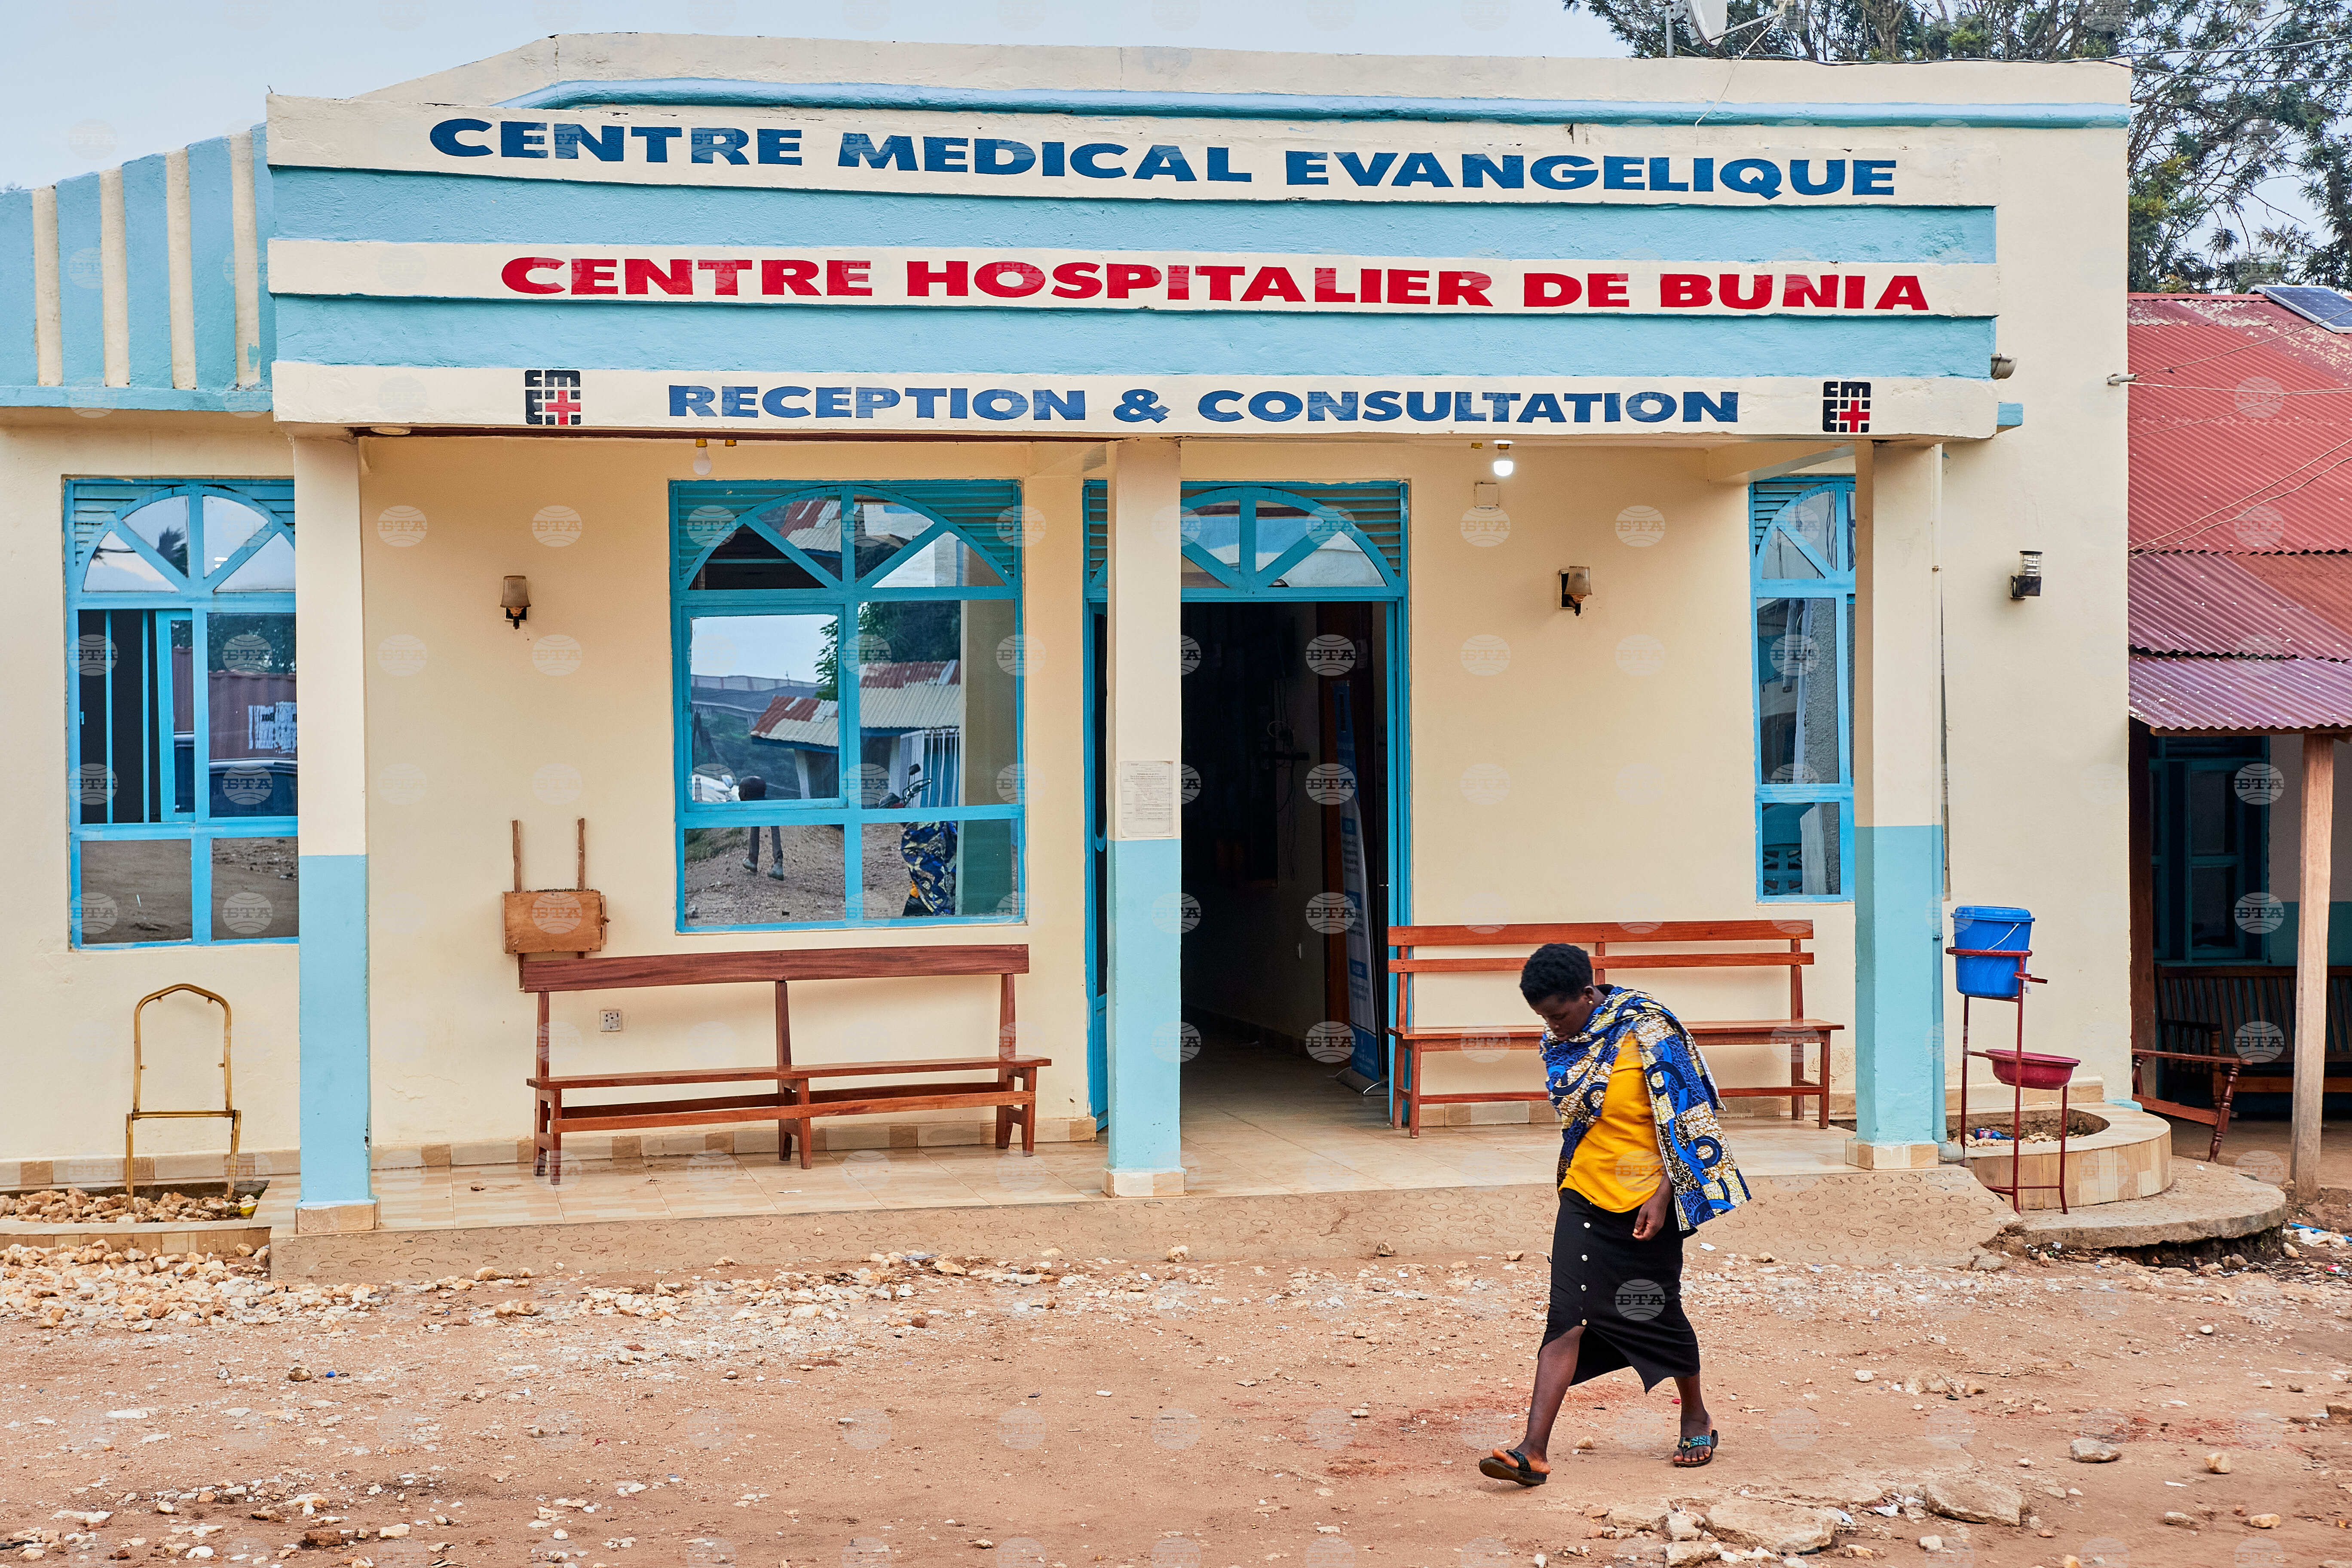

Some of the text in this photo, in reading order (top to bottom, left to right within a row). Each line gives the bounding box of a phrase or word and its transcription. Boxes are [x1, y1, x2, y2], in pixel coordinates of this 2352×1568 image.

[430, 119, 1896, 199] CENTRE MEDICAL EVANGELIQUE
[501, 256, 1929, 311] CENTRE HOSPITALIER DE BUNIA
[669, 385, 1738, 423] RECEPTION & CONSULTATION
